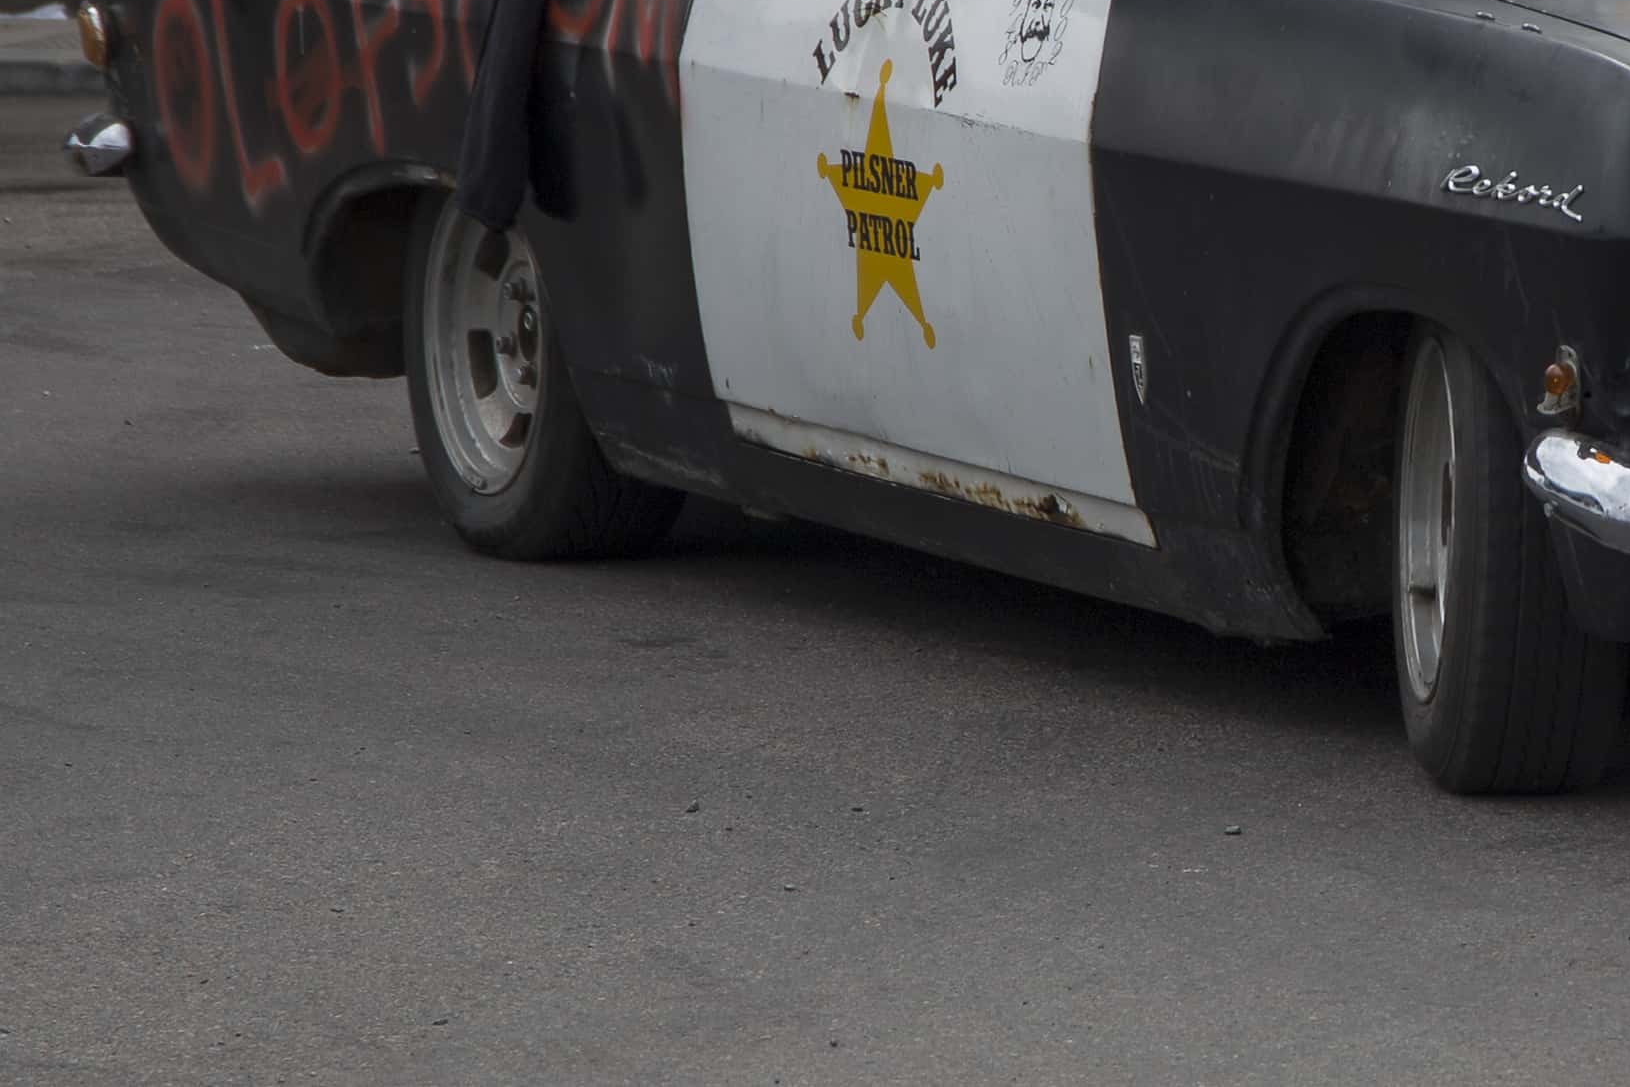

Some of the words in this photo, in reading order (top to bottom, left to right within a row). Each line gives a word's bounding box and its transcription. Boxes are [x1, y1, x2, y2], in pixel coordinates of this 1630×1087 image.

[840, 149, 919, 201] PILSNER
[1440, 165, 1583, 222] Rekord
[845, 209, 920, 261] PATROL
